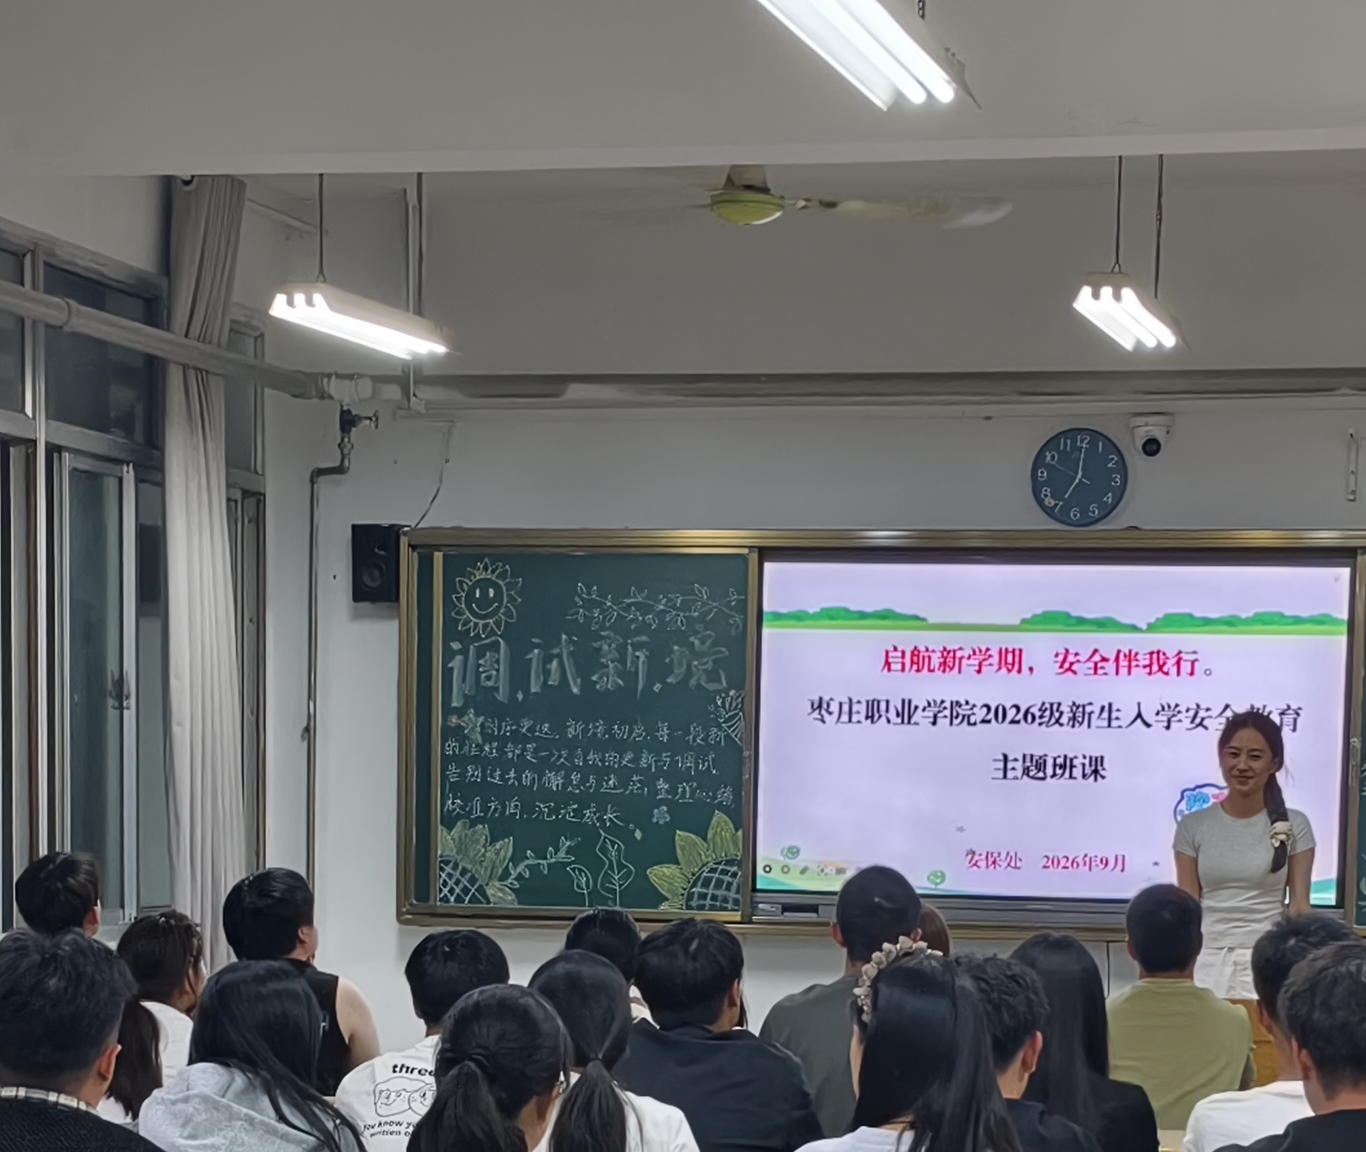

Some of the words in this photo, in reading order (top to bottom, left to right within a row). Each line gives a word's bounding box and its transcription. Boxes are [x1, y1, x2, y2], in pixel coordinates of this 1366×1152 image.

[1107, 455, 1118, 468] 2
[1037, 468, 1047, 481] 9
[1111, 474, 1121, 486] 3
[1070, 507, 1081, 520] 6
[1088, 504, 1099, 517] 5
[881, 645, 1214, 678] 启航新学期，安全伴我行。
[807, 696, 1303, 733] 枣庄职业学院2026级新生入学安全育
[991, 752, 1108, 783] 主题班课
[965, 849, 1023, 870] 安保处
[1041, 853, 1127, 873] 2026年9月
